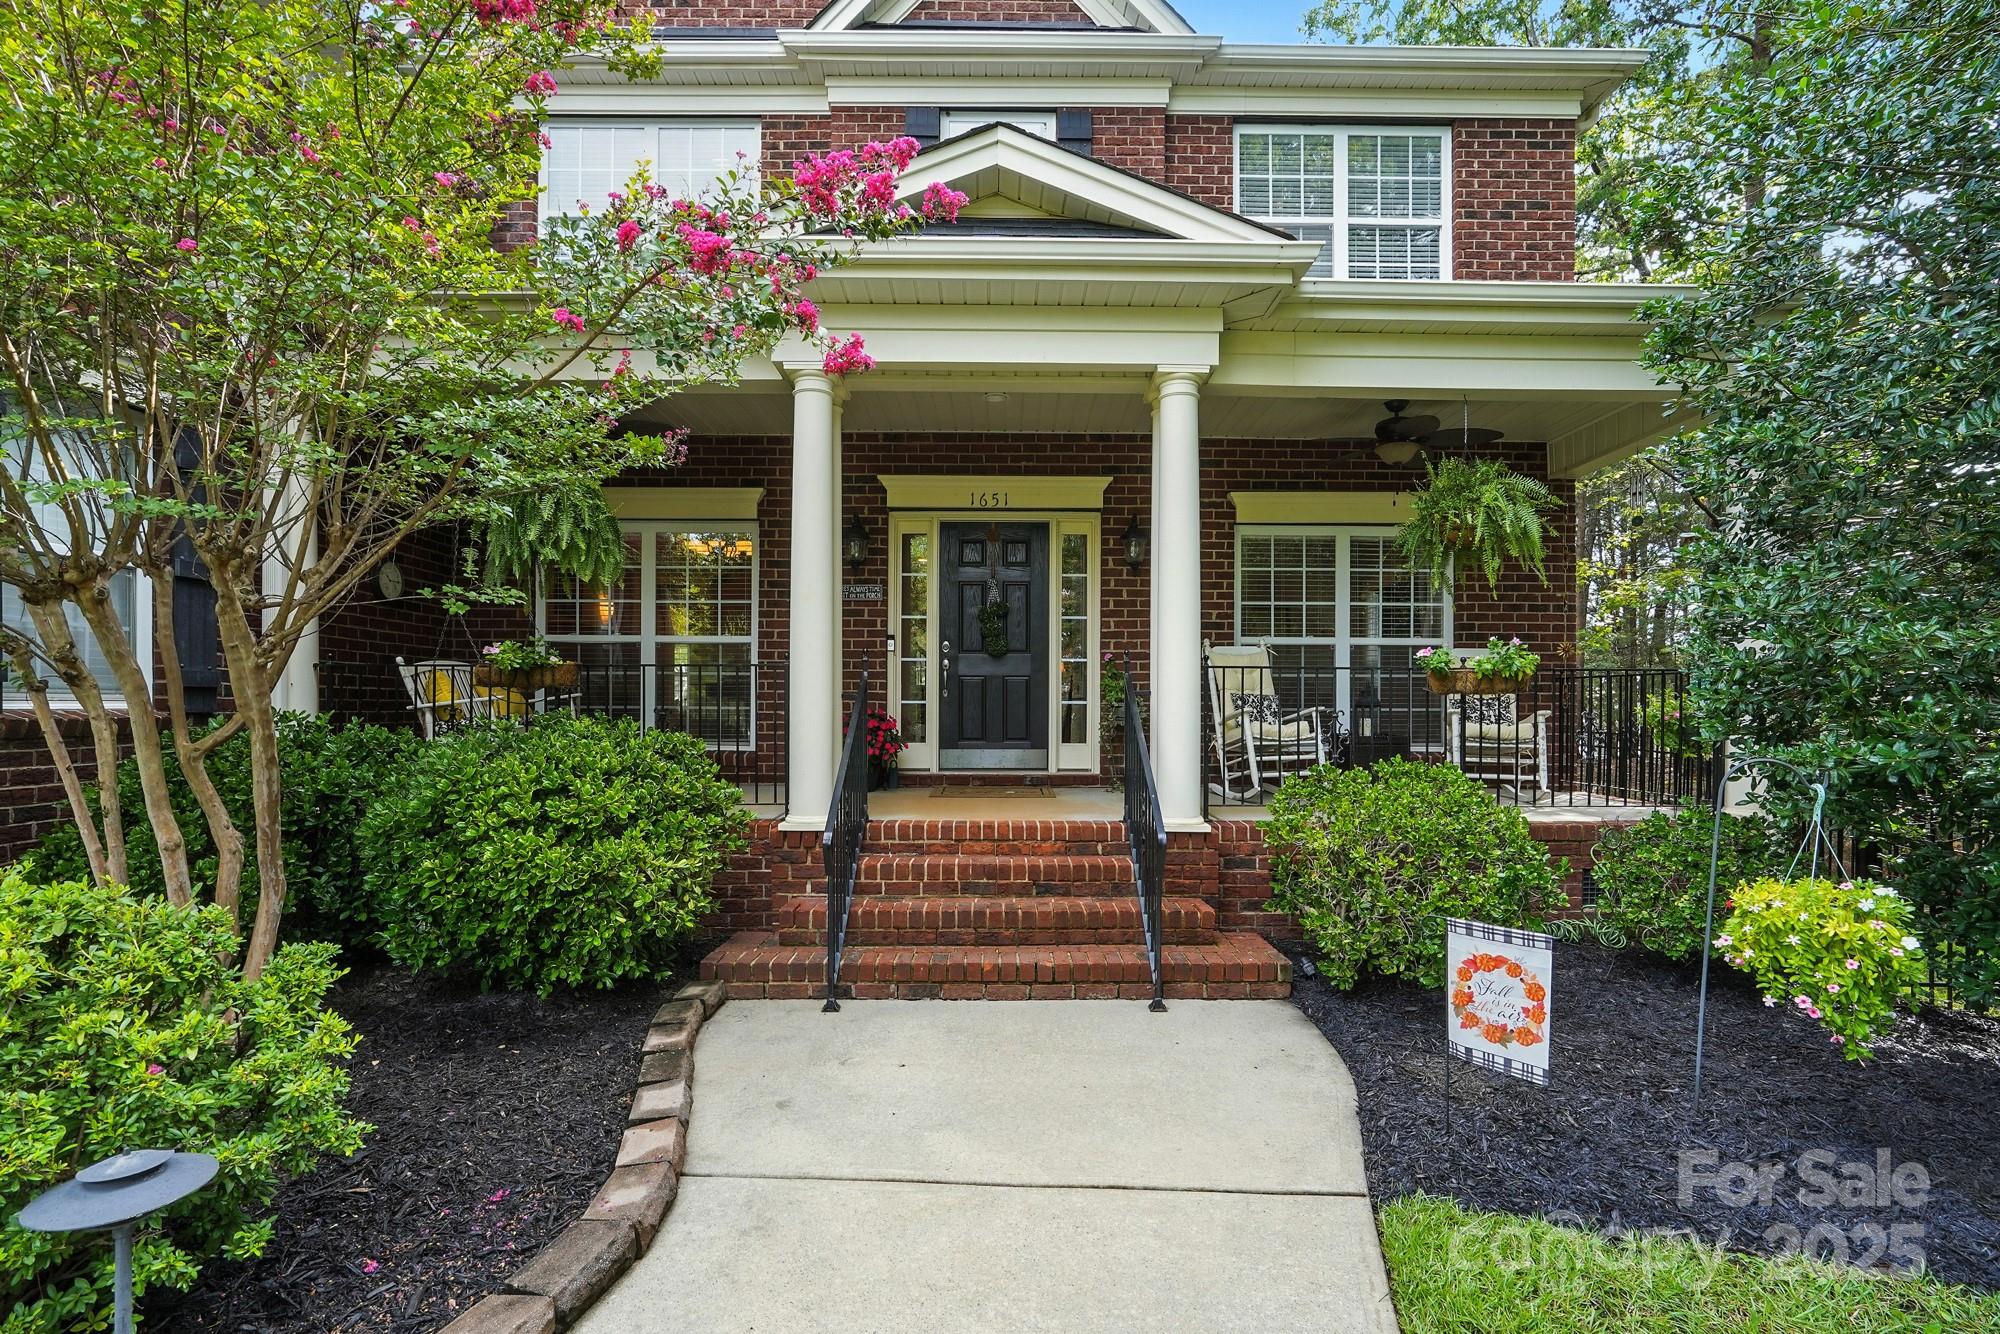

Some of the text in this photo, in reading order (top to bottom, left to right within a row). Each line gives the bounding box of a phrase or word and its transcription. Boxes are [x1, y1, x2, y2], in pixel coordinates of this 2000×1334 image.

[970, 492, 1008, 507] 1651
[1474, 978, 1514, 997] Fall
[1491, 997, 1500, 1007] is
[1474, 1001, 1523, 1022] the air
